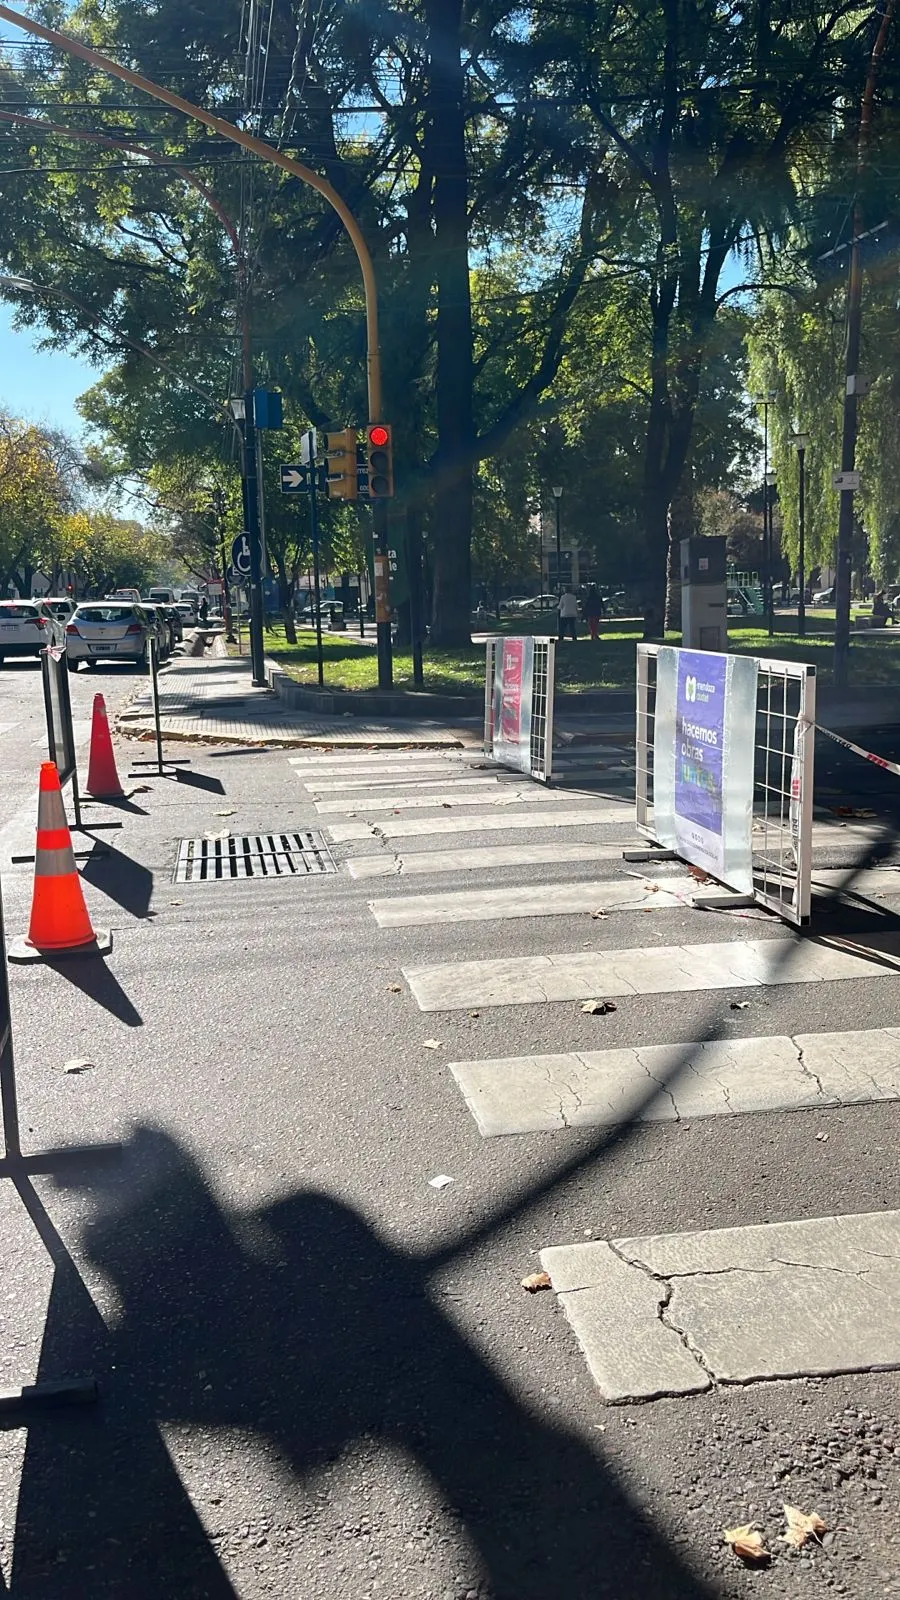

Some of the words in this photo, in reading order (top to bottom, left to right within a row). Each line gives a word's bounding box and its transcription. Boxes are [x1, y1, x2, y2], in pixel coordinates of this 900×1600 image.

[696, 682, 716, 693] mendoza
[682, 716, 717, 744] hacemos
[681, 738, 704, 762] obras
